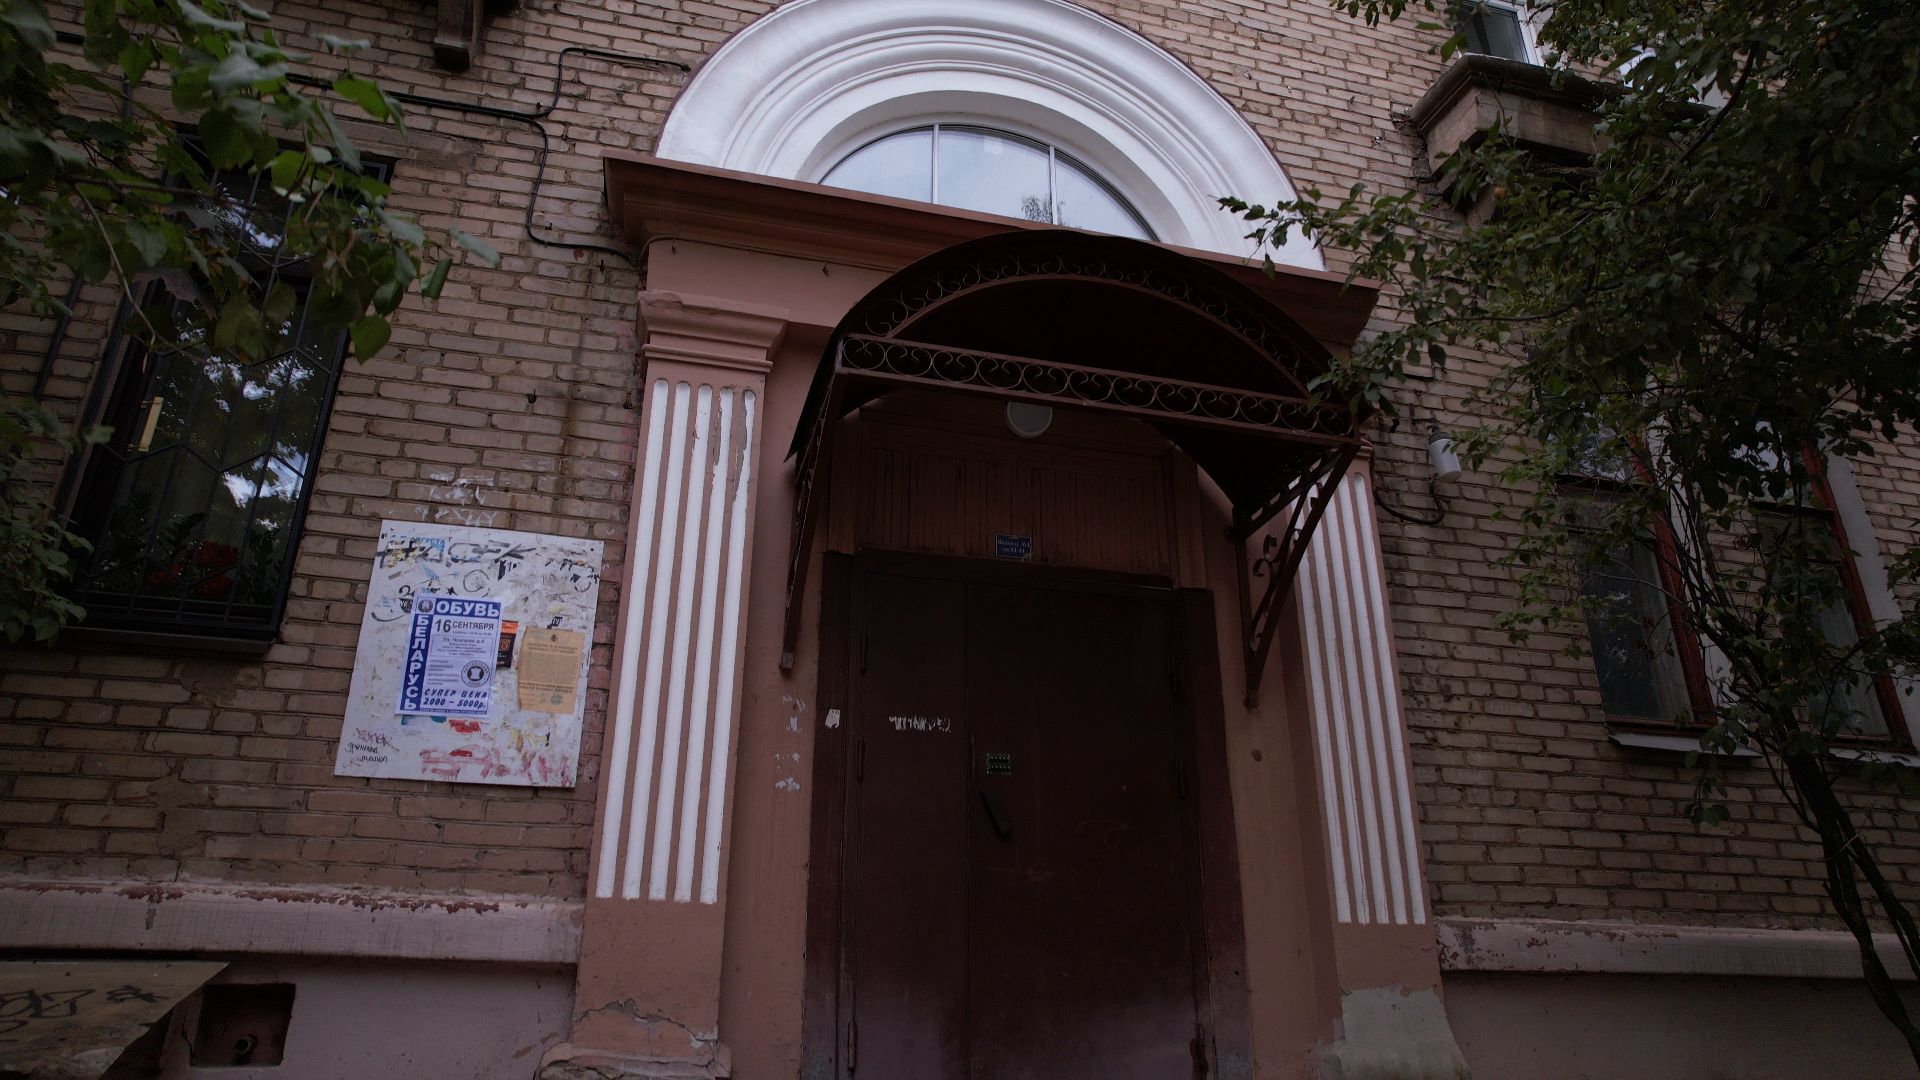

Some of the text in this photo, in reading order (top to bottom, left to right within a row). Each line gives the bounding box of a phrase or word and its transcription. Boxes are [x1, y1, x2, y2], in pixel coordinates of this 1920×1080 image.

[436, 600, 500, 618] ОБУВЬ
[435, 619, 494, 633] 16 СЕНТЯБРЯ
[403, 615, 430, 710] БЕЛАРУСЬ
[424, 688, 487, 699] СУПЕР ЦЕНА
[423, 697, 446, 706] 2000
[457, 699, 486, 709] 5000р.
